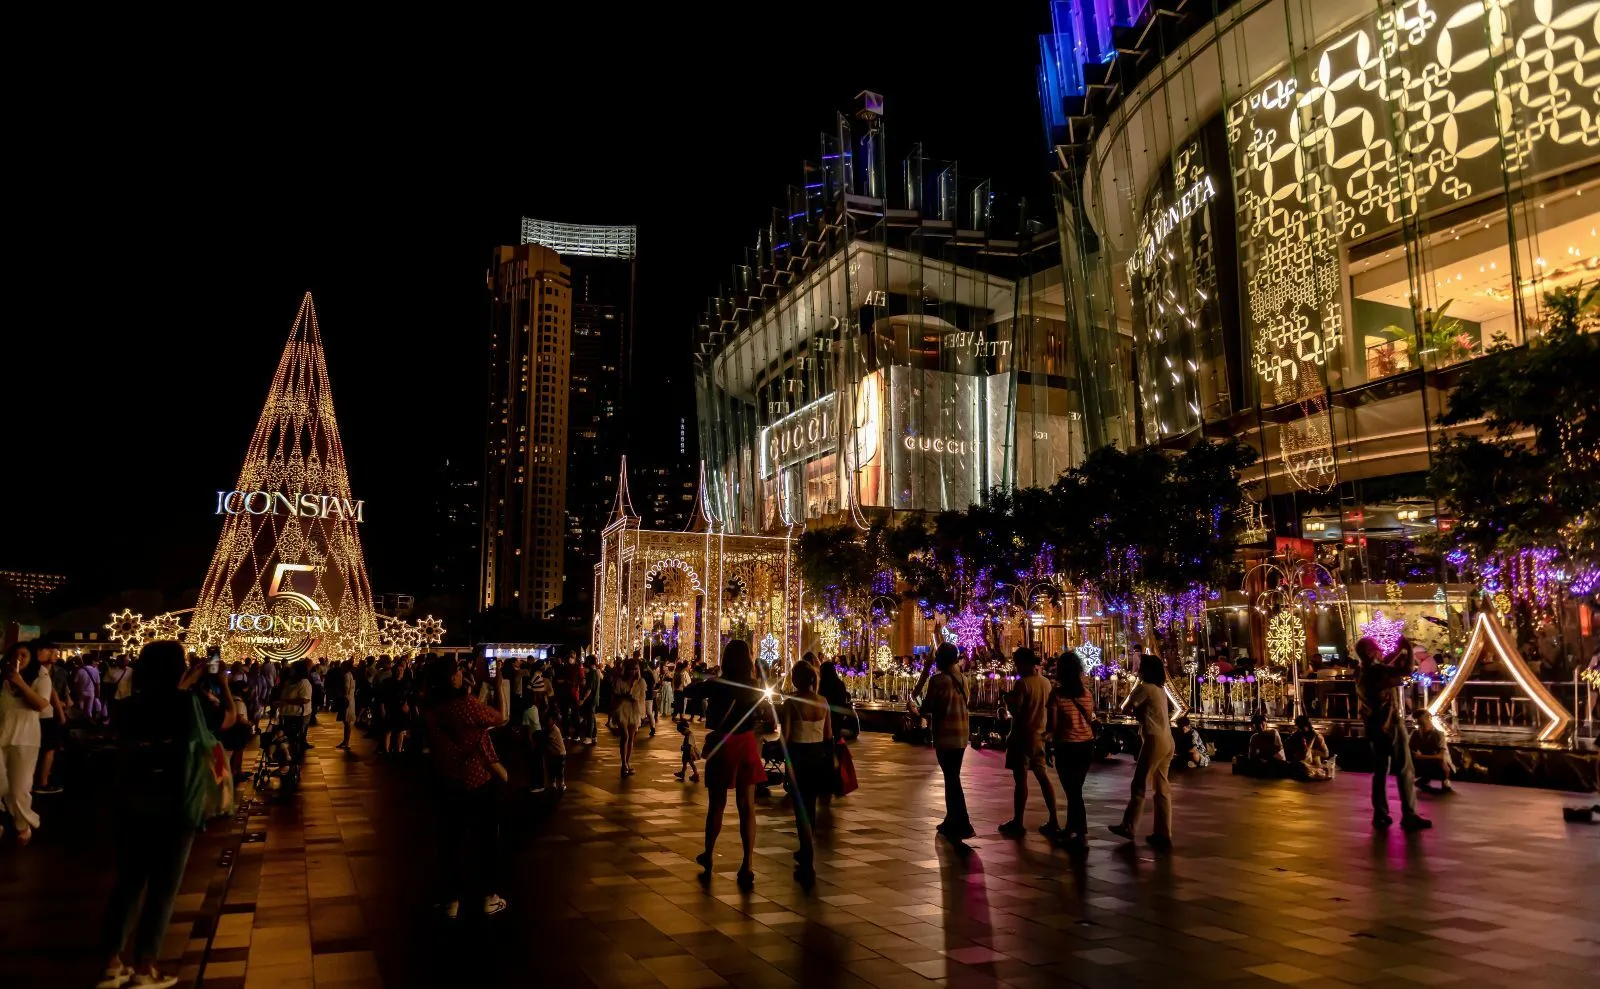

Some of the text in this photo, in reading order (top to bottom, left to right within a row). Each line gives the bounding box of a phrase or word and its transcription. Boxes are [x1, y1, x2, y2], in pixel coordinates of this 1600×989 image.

[1154, 175, 1216, 245] VENETA
[769, 411, 827, 460] GUCCI
[904, 435, 966, 455] GUCCI
[215, 491, 365, 523] ICONSIAM
[228, 613, 339, 633] ICONSIAM
[230, 636, 291, 645] ANNIVERSARY
